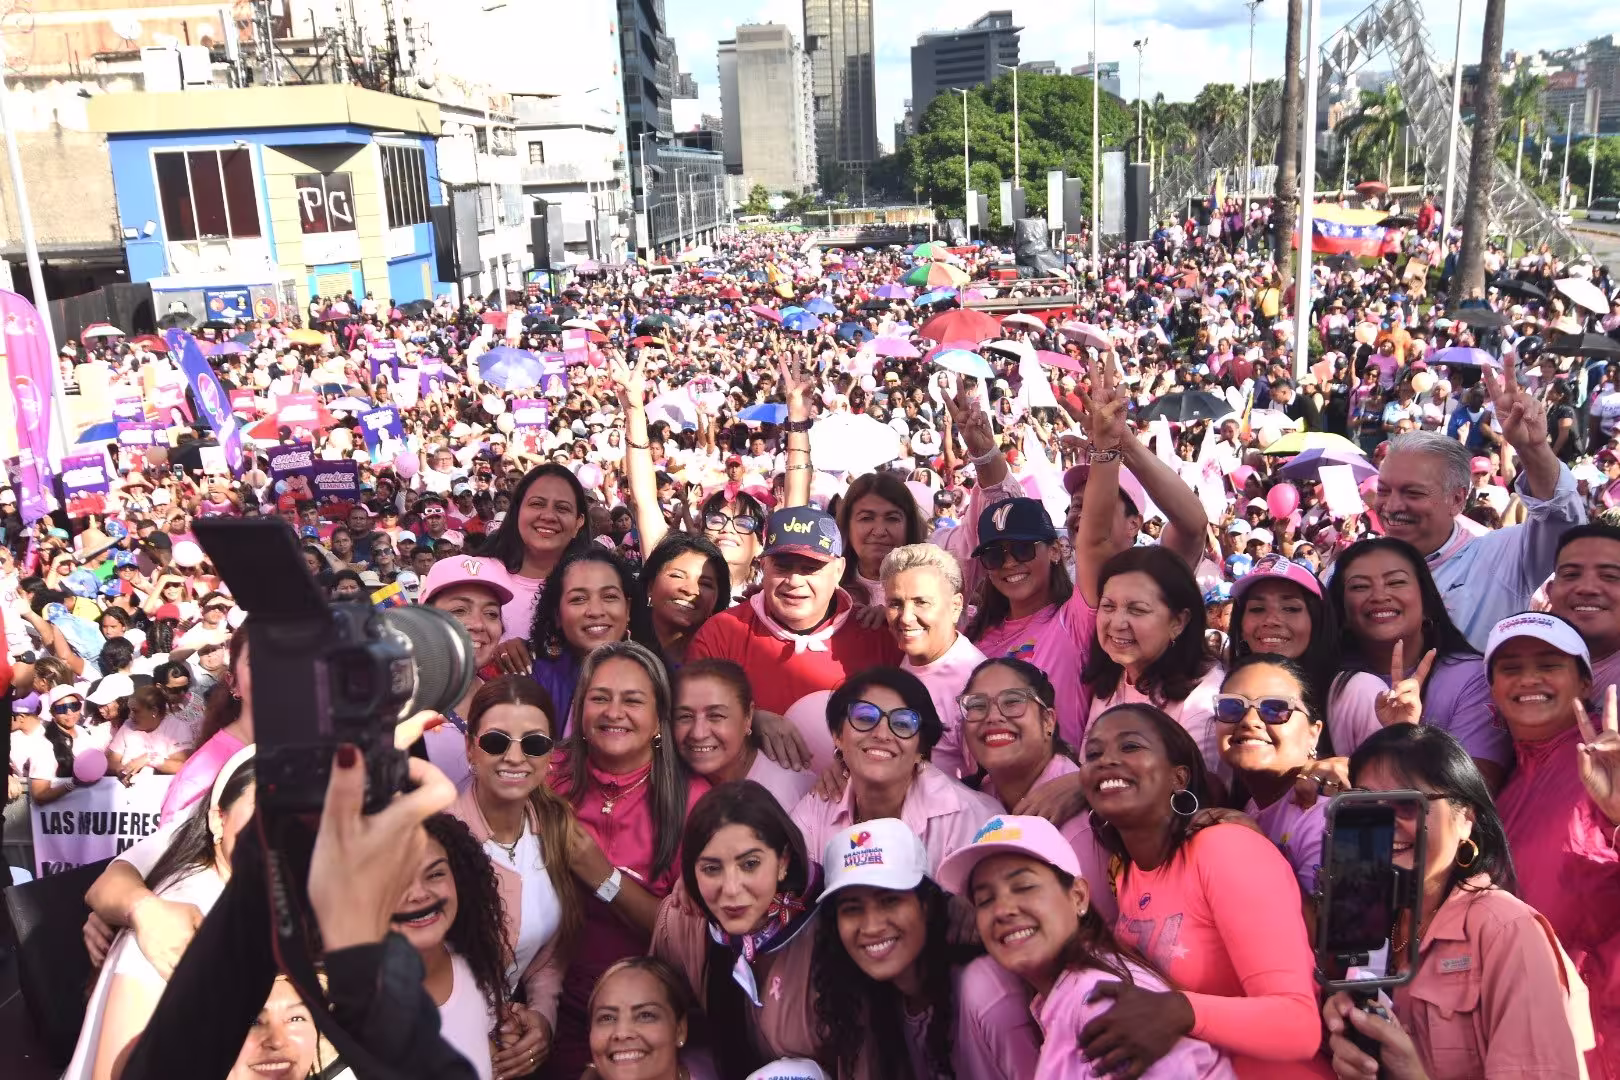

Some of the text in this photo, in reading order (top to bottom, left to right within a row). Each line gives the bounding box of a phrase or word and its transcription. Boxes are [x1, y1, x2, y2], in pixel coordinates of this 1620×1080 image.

[41, 811, 161, 836] LAS MUJERES
[844, 856, 882, 867] MUJER
